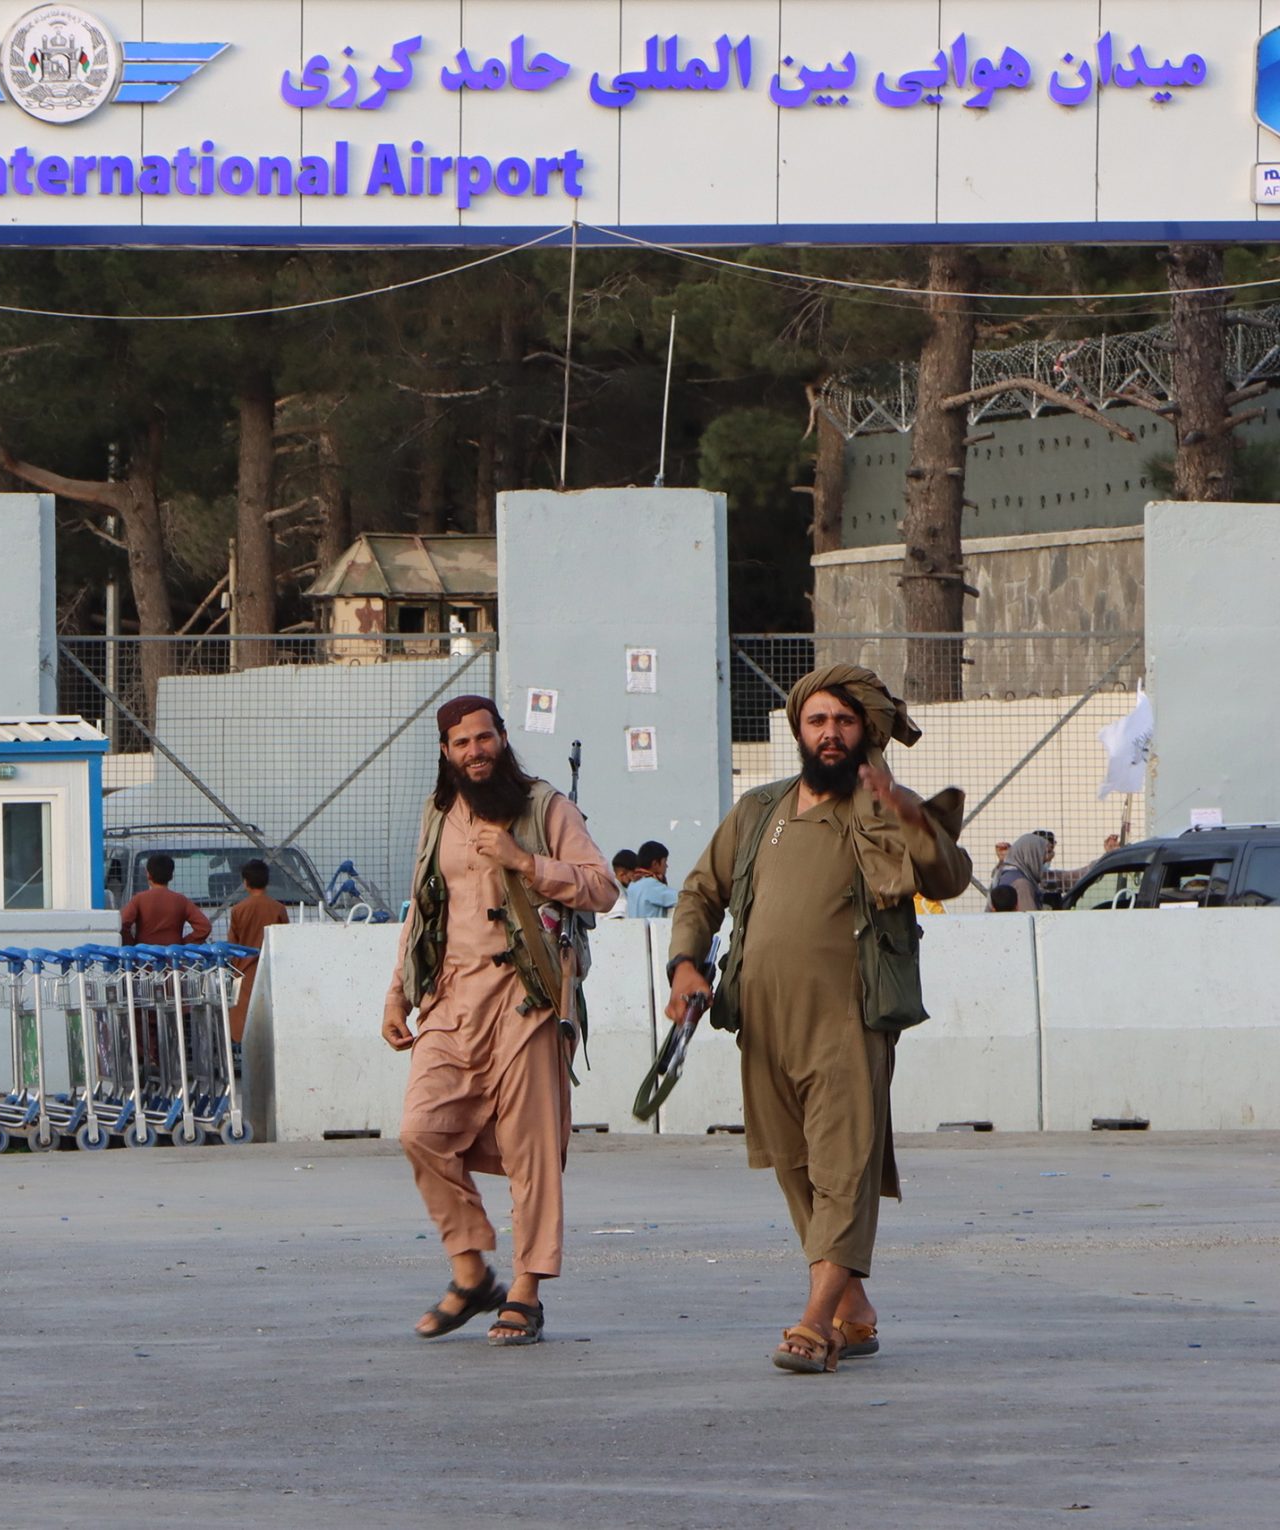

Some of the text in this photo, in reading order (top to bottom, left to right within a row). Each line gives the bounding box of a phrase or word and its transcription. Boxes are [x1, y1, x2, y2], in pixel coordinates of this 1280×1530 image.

[281, 31, 1207, 110] میدان هوایی بین المللی حامد کرزی
[366, 140, 585, 206] Airport
